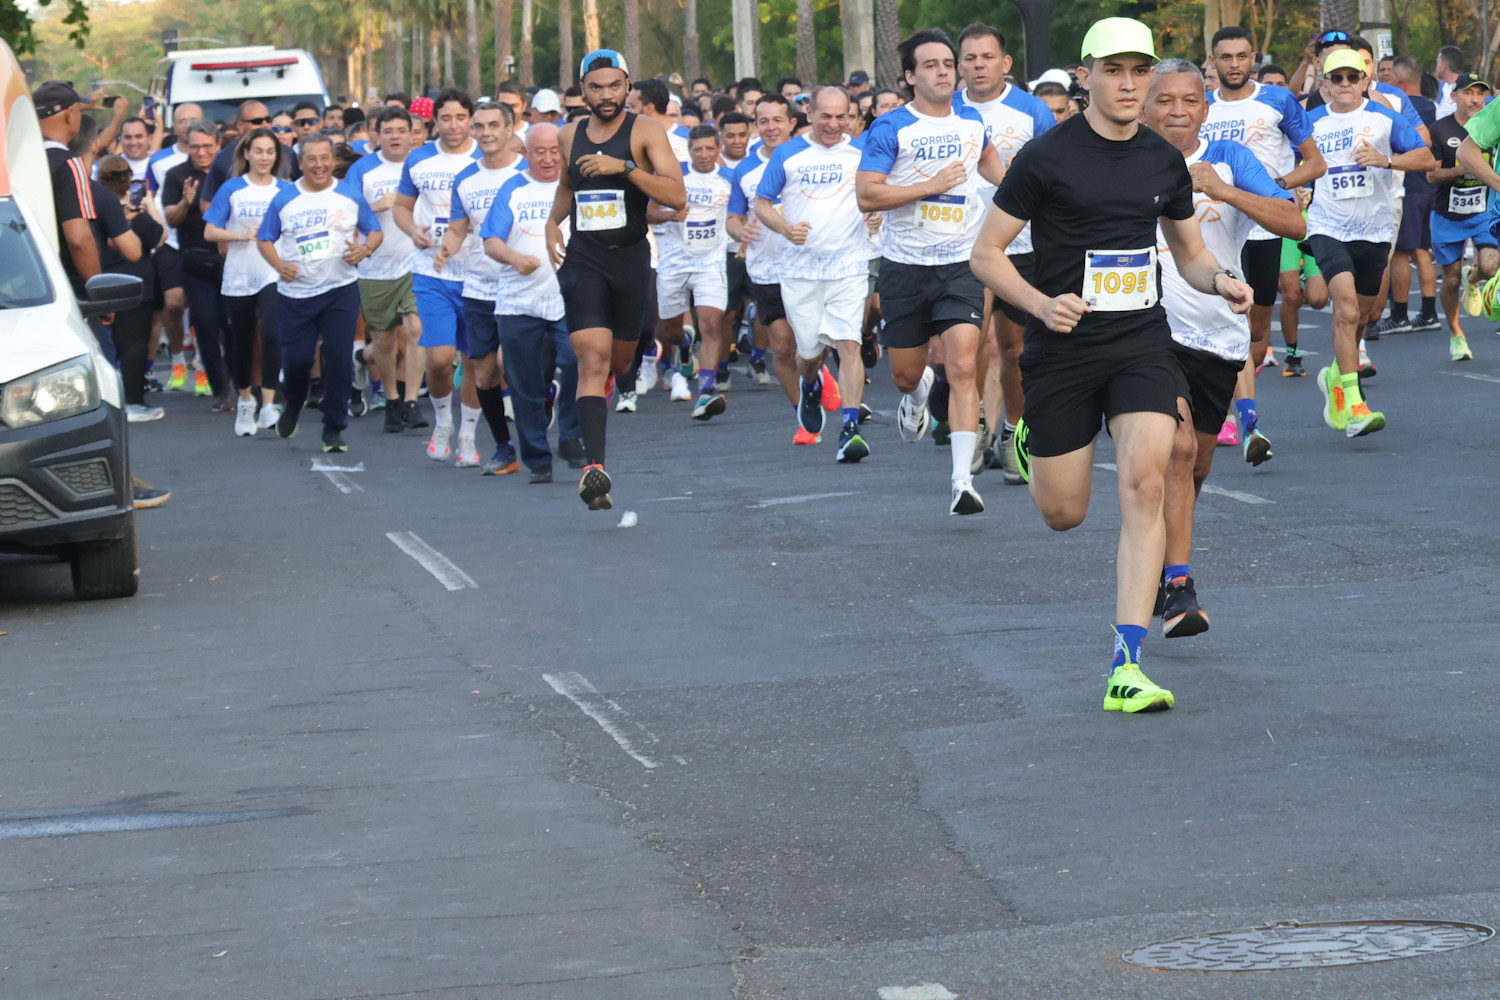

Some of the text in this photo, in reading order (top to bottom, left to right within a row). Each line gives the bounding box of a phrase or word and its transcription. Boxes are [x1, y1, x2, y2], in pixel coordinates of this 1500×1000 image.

[1200, 119, 1245, 133] CORRIDA
[911, 134, 960, 148] CORRIDA
[1315, 127, 1354, 143] CORRIDA
[914, 143, 962, 161] ALEPI
[1318, 136, 1353, 154] ALEPI
[798, 164, 843, 174] CORRIDA
[800, 172, 843, 184] ALEPI
[1332, 175, 1366, 190] 5612
[688, 194, 712, 204] LEPI
[1453, 195, 1480, 207] 5345
[289, 208, 327, 222] CORRIDA
[920, 204, 964, 223] 1050
[292, 216, 327, 233] ALEPI
[688, 227, 716, 240] 5525
[299, 239, 330, 255] 3047
[1092, 271, 1147, 294] 1095
